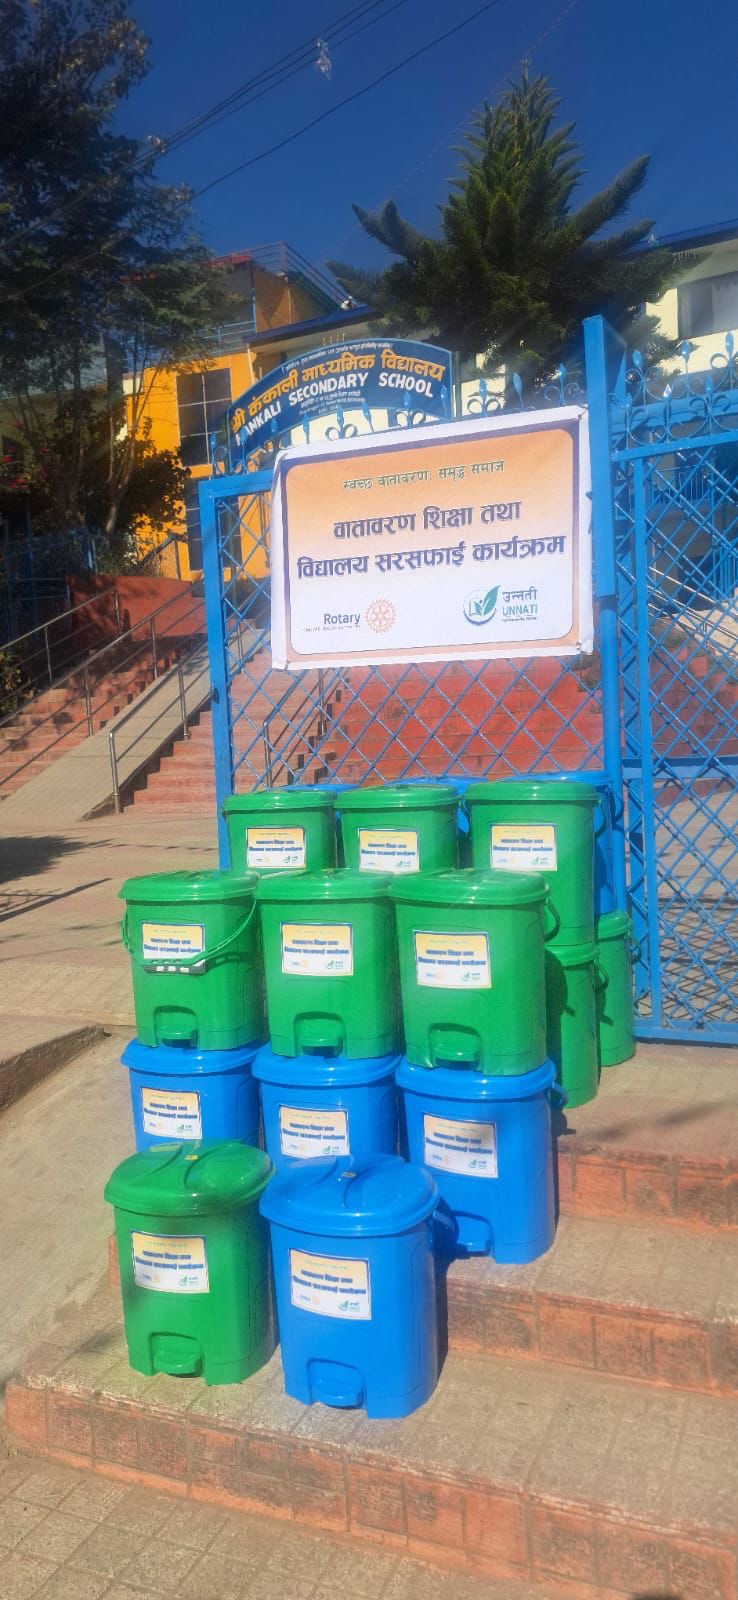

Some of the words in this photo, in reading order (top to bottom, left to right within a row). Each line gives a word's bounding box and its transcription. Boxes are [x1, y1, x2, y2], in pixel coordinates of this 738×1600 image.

[248, 369, 299, 416] कंकाली
[301, 351, 376, 382] माध्यमिक
[381, 348, 446, 382] विद्यालय
[288, 372, 368, 406] SECONDARY
[378, 372, 433, 398] SCHOOL
[438, 466, 465, 480] समृद्ध
[471, 460, 504, 475] समाज
[333, 513, 417, 539] वातावरण
[423, 505, 473, 529] शिक्षा
[480, 501, 522, 524] तथा
[297, 555, 369, 580] विद्यालय
[472, 535, 566, 562] कार्यक्रम
[502, 585, 538, 602] उन्नती
[323, 612, 361, 625] Rotary
[502, 603, 538, 616] UNNATI
